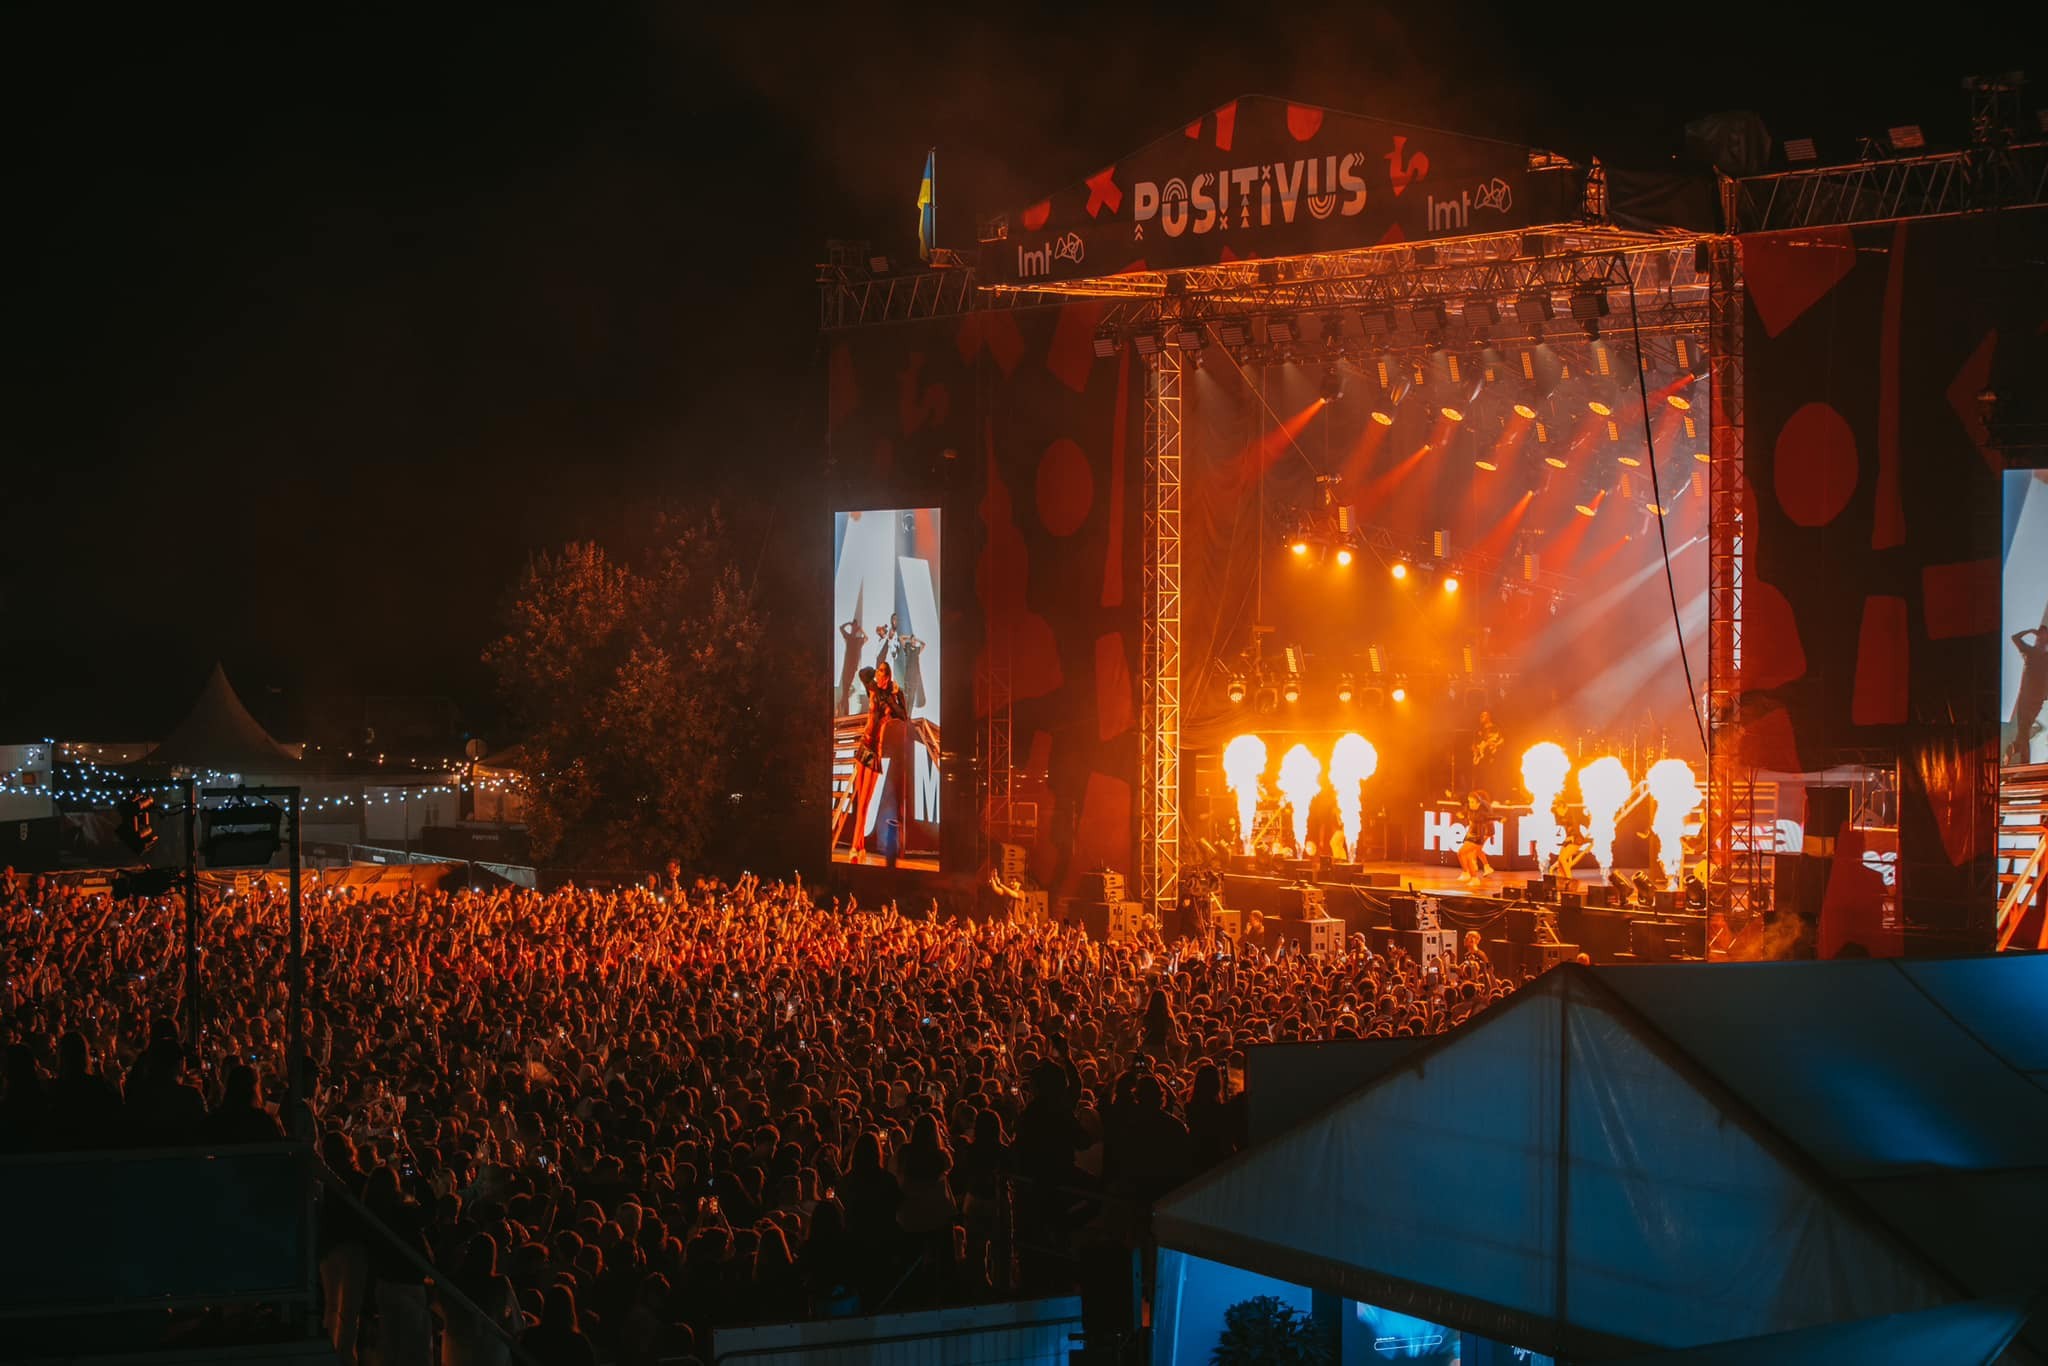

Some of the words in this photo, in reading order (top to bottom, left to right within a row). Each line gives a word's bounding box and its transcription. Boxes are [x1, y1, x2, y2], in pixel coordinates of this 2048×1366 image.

[1134, 152, 1367, 240] POSITIVUS
[1427, 190, 1471, 232] lmt
[1018, 241, 1052, 277] lmt
[1424, 811, 1504, 857] Hed
